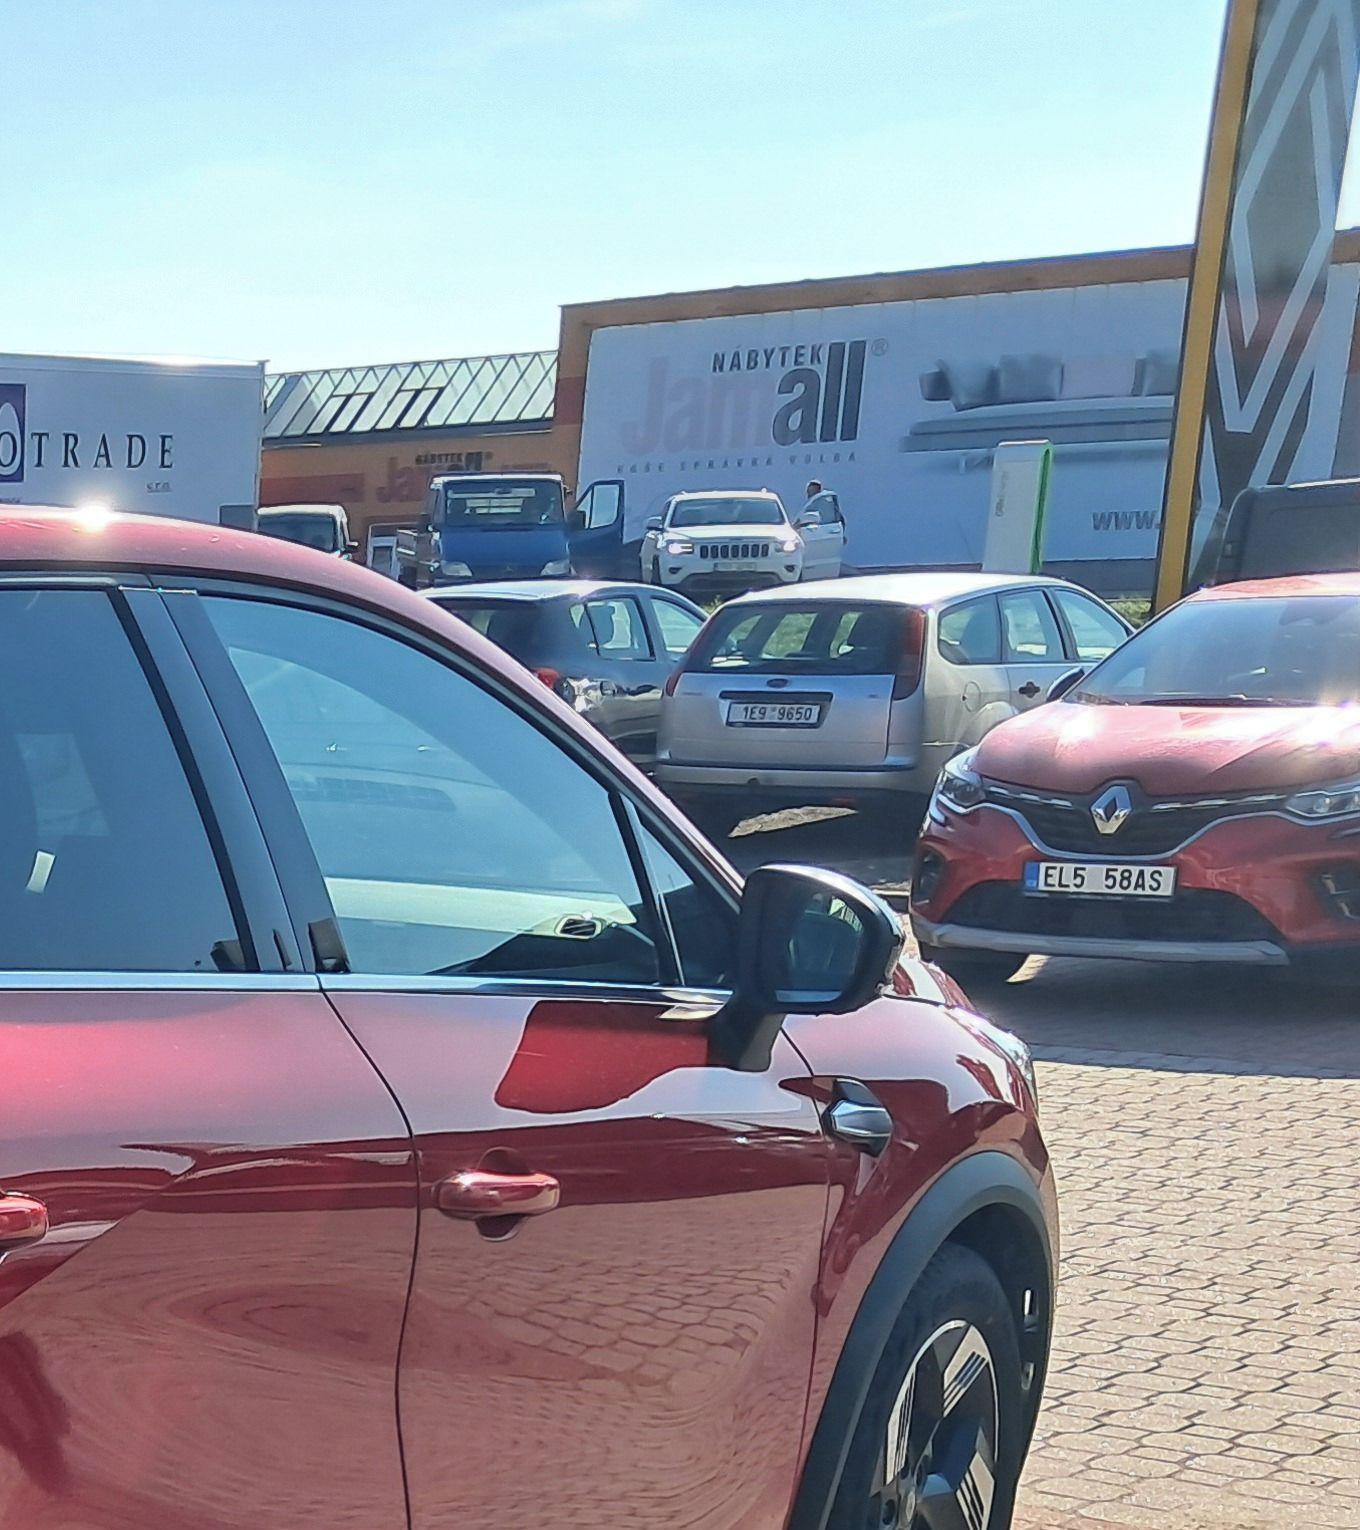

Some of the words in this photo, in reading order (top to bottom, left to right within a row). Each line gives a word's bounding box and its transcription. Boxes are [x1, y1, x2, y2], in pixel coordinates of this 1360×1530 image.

[712, 343, 823, 373] NÁBYTEK
[743, 706, 767, 721] 1E9
[776, 706, 813, 721] 9650
[1044, 865, 1086, 889] EL5
[1104, 866, 1164, 893] 58AS
